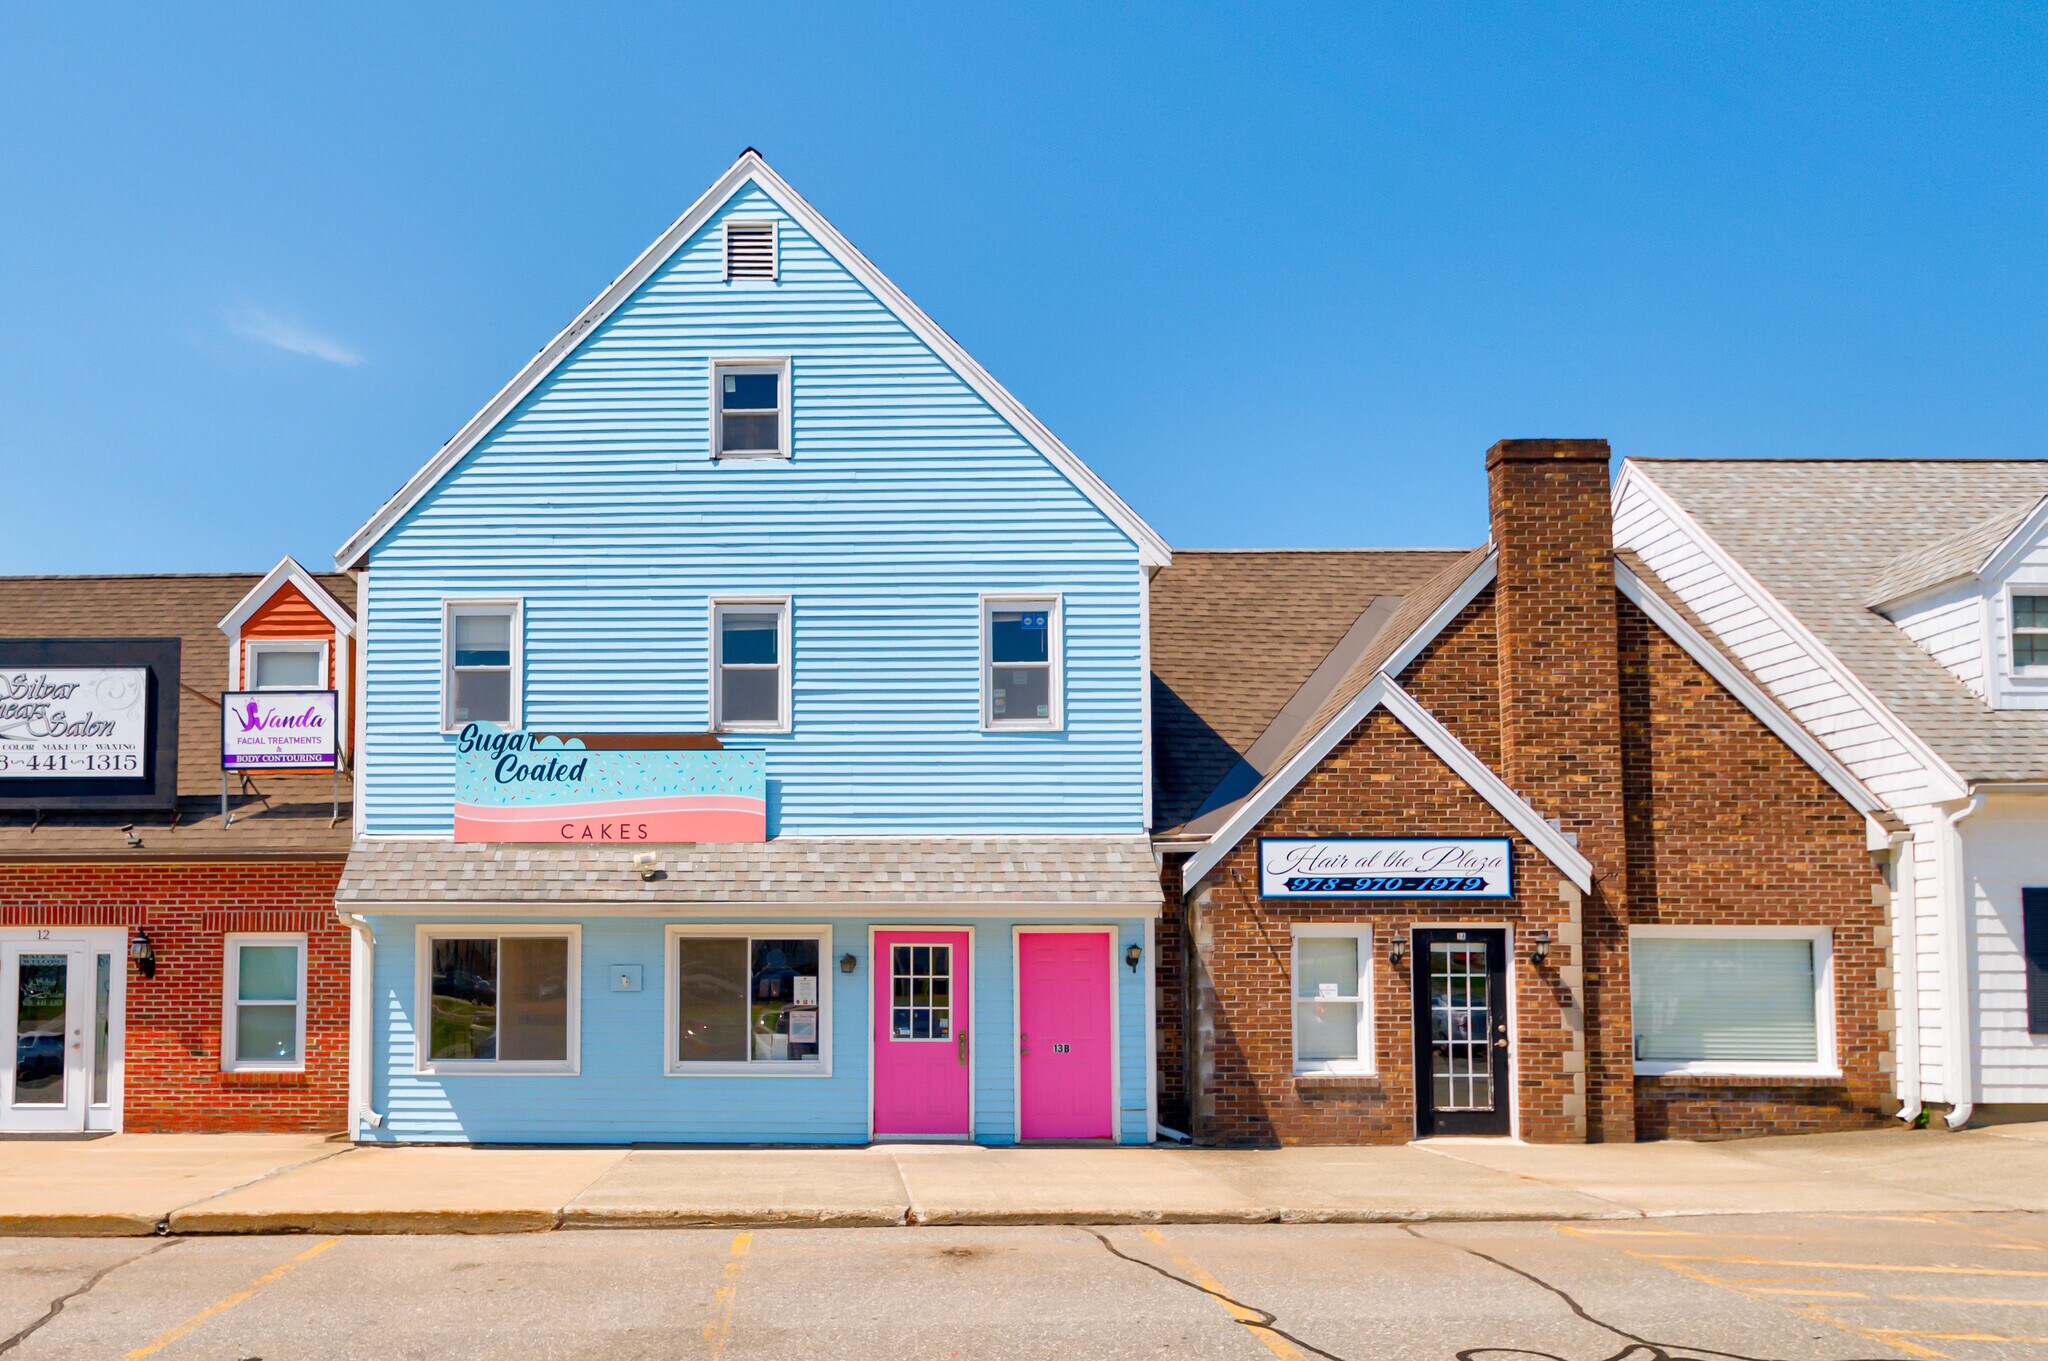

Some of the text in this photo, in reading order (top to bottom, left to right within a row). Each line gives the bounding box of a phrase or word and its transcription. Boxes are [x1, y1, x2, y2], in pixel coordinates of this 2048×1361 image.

[27, 710, 116, 737] Salon
[232, 702, 327, 732] Wanda
[2, 743, 35, 751] COLOR
[95, 743, 136, 751] WAXING
[237, 736, 322, 745] FACIAL TREATMENTS
[458, 723, 535, 760] Sugar
[236, 754, 323, 763] BODY CONTOURING
[494, 754, 588, 784] Coated
[560, 823, 649, 840] CAKES
[1266, 845, 1504, 876] Hair at the Plaza
[1290, 877, 1483, 892] 978-970-1979
[37, 929, 50, 940] 12
[1053, 1044, 1070, 1053] 13B
